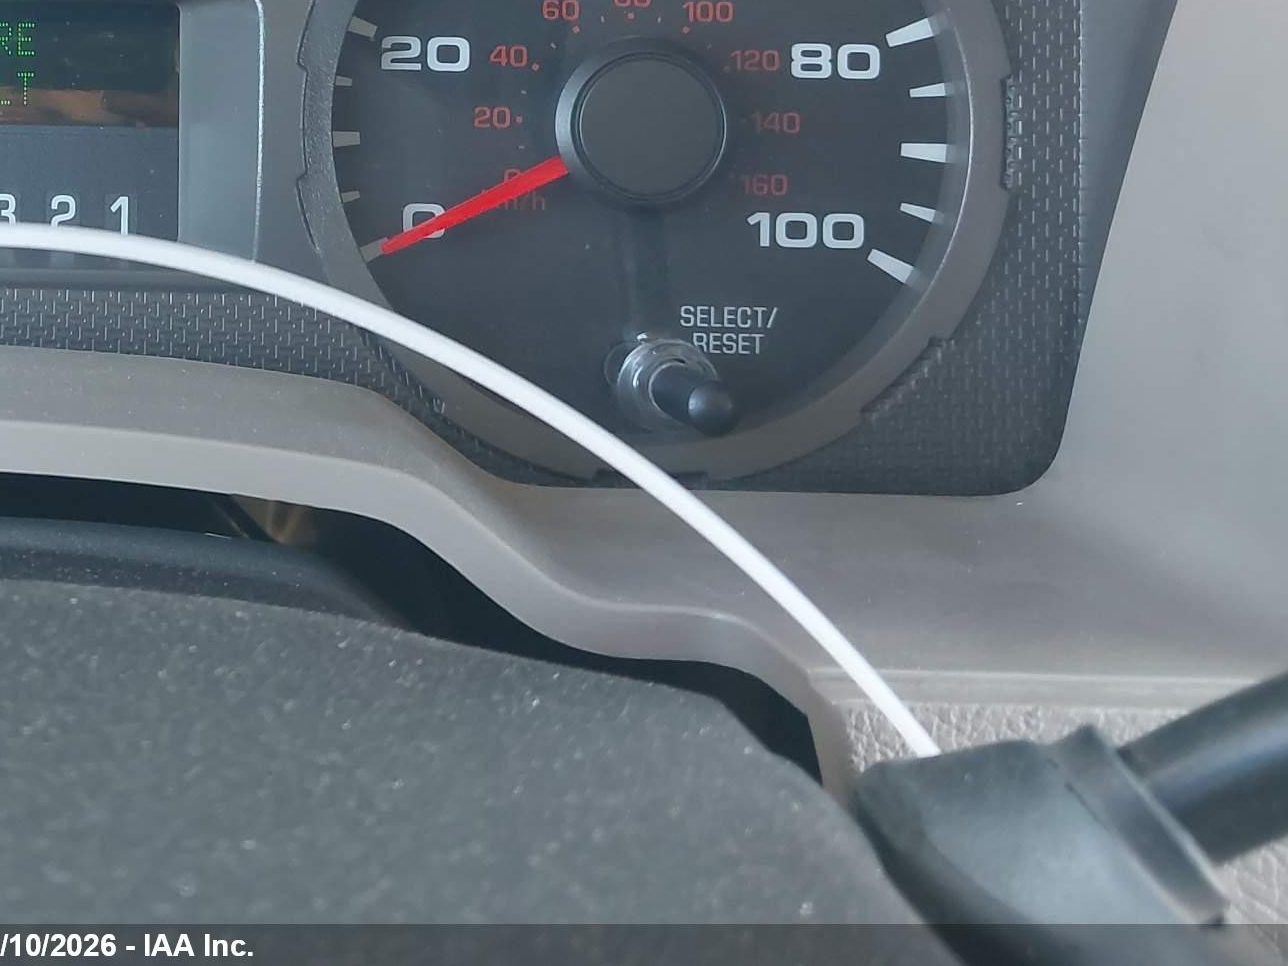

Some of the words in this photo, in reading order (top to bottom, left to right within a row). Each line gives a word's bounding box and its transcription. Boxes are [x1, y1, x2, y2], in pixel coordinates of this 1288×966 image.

[682, 0, 734, 23] 100
[381, 36, 471, 72] 20
[489, 45, 529, 67] 40
[732, 49, 781, 72] 120
[790, 43, 881, 80] 80
[473, 107, 511, 129] 20
[752, 111, 800, 134] 140
[744, 174, 788, 196] 160
[50, 194, 76, 226] 2
[110, 196, 130, 235] 1
[402, 203, 446, 239] 0
[746, 211, 865, 250] 100
[680, 305, 778, 329] SELECT/
[693, 333, 764, 355] RESET
